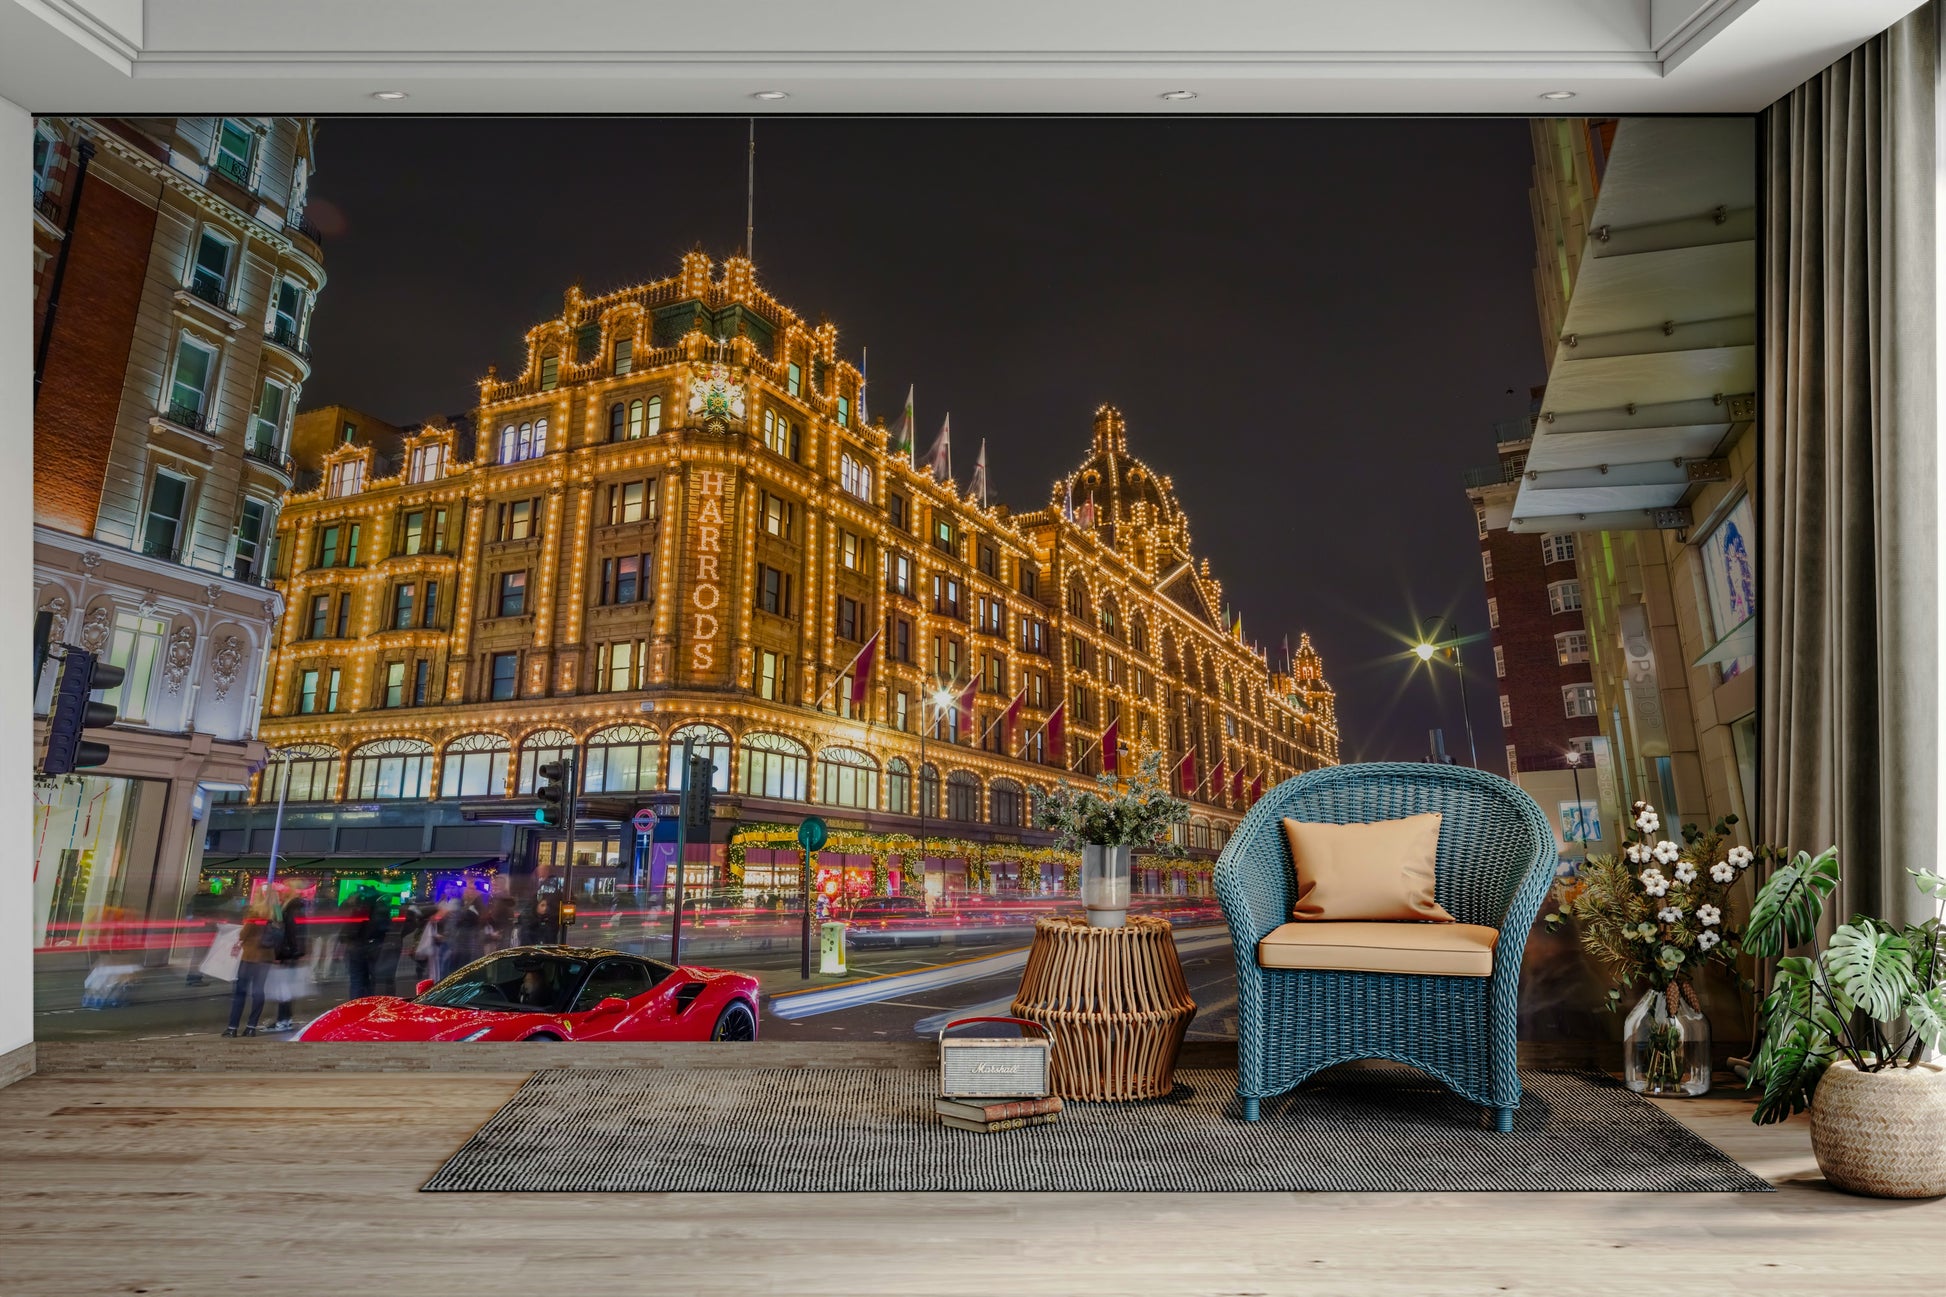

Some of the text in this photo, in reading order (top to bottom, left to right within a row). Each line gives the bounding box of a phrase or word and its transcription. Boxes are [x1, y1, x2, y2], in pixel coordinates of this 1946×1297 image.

[693, 470, 725, 670] HARRODS
[1626, 630, 1662, 729] TOPSHOP
[33, 782, 59, 790] ARA
[1596, 752, 1614, 803] TOPSHOP
[971, 1061, 1020, 1074] Marshall
